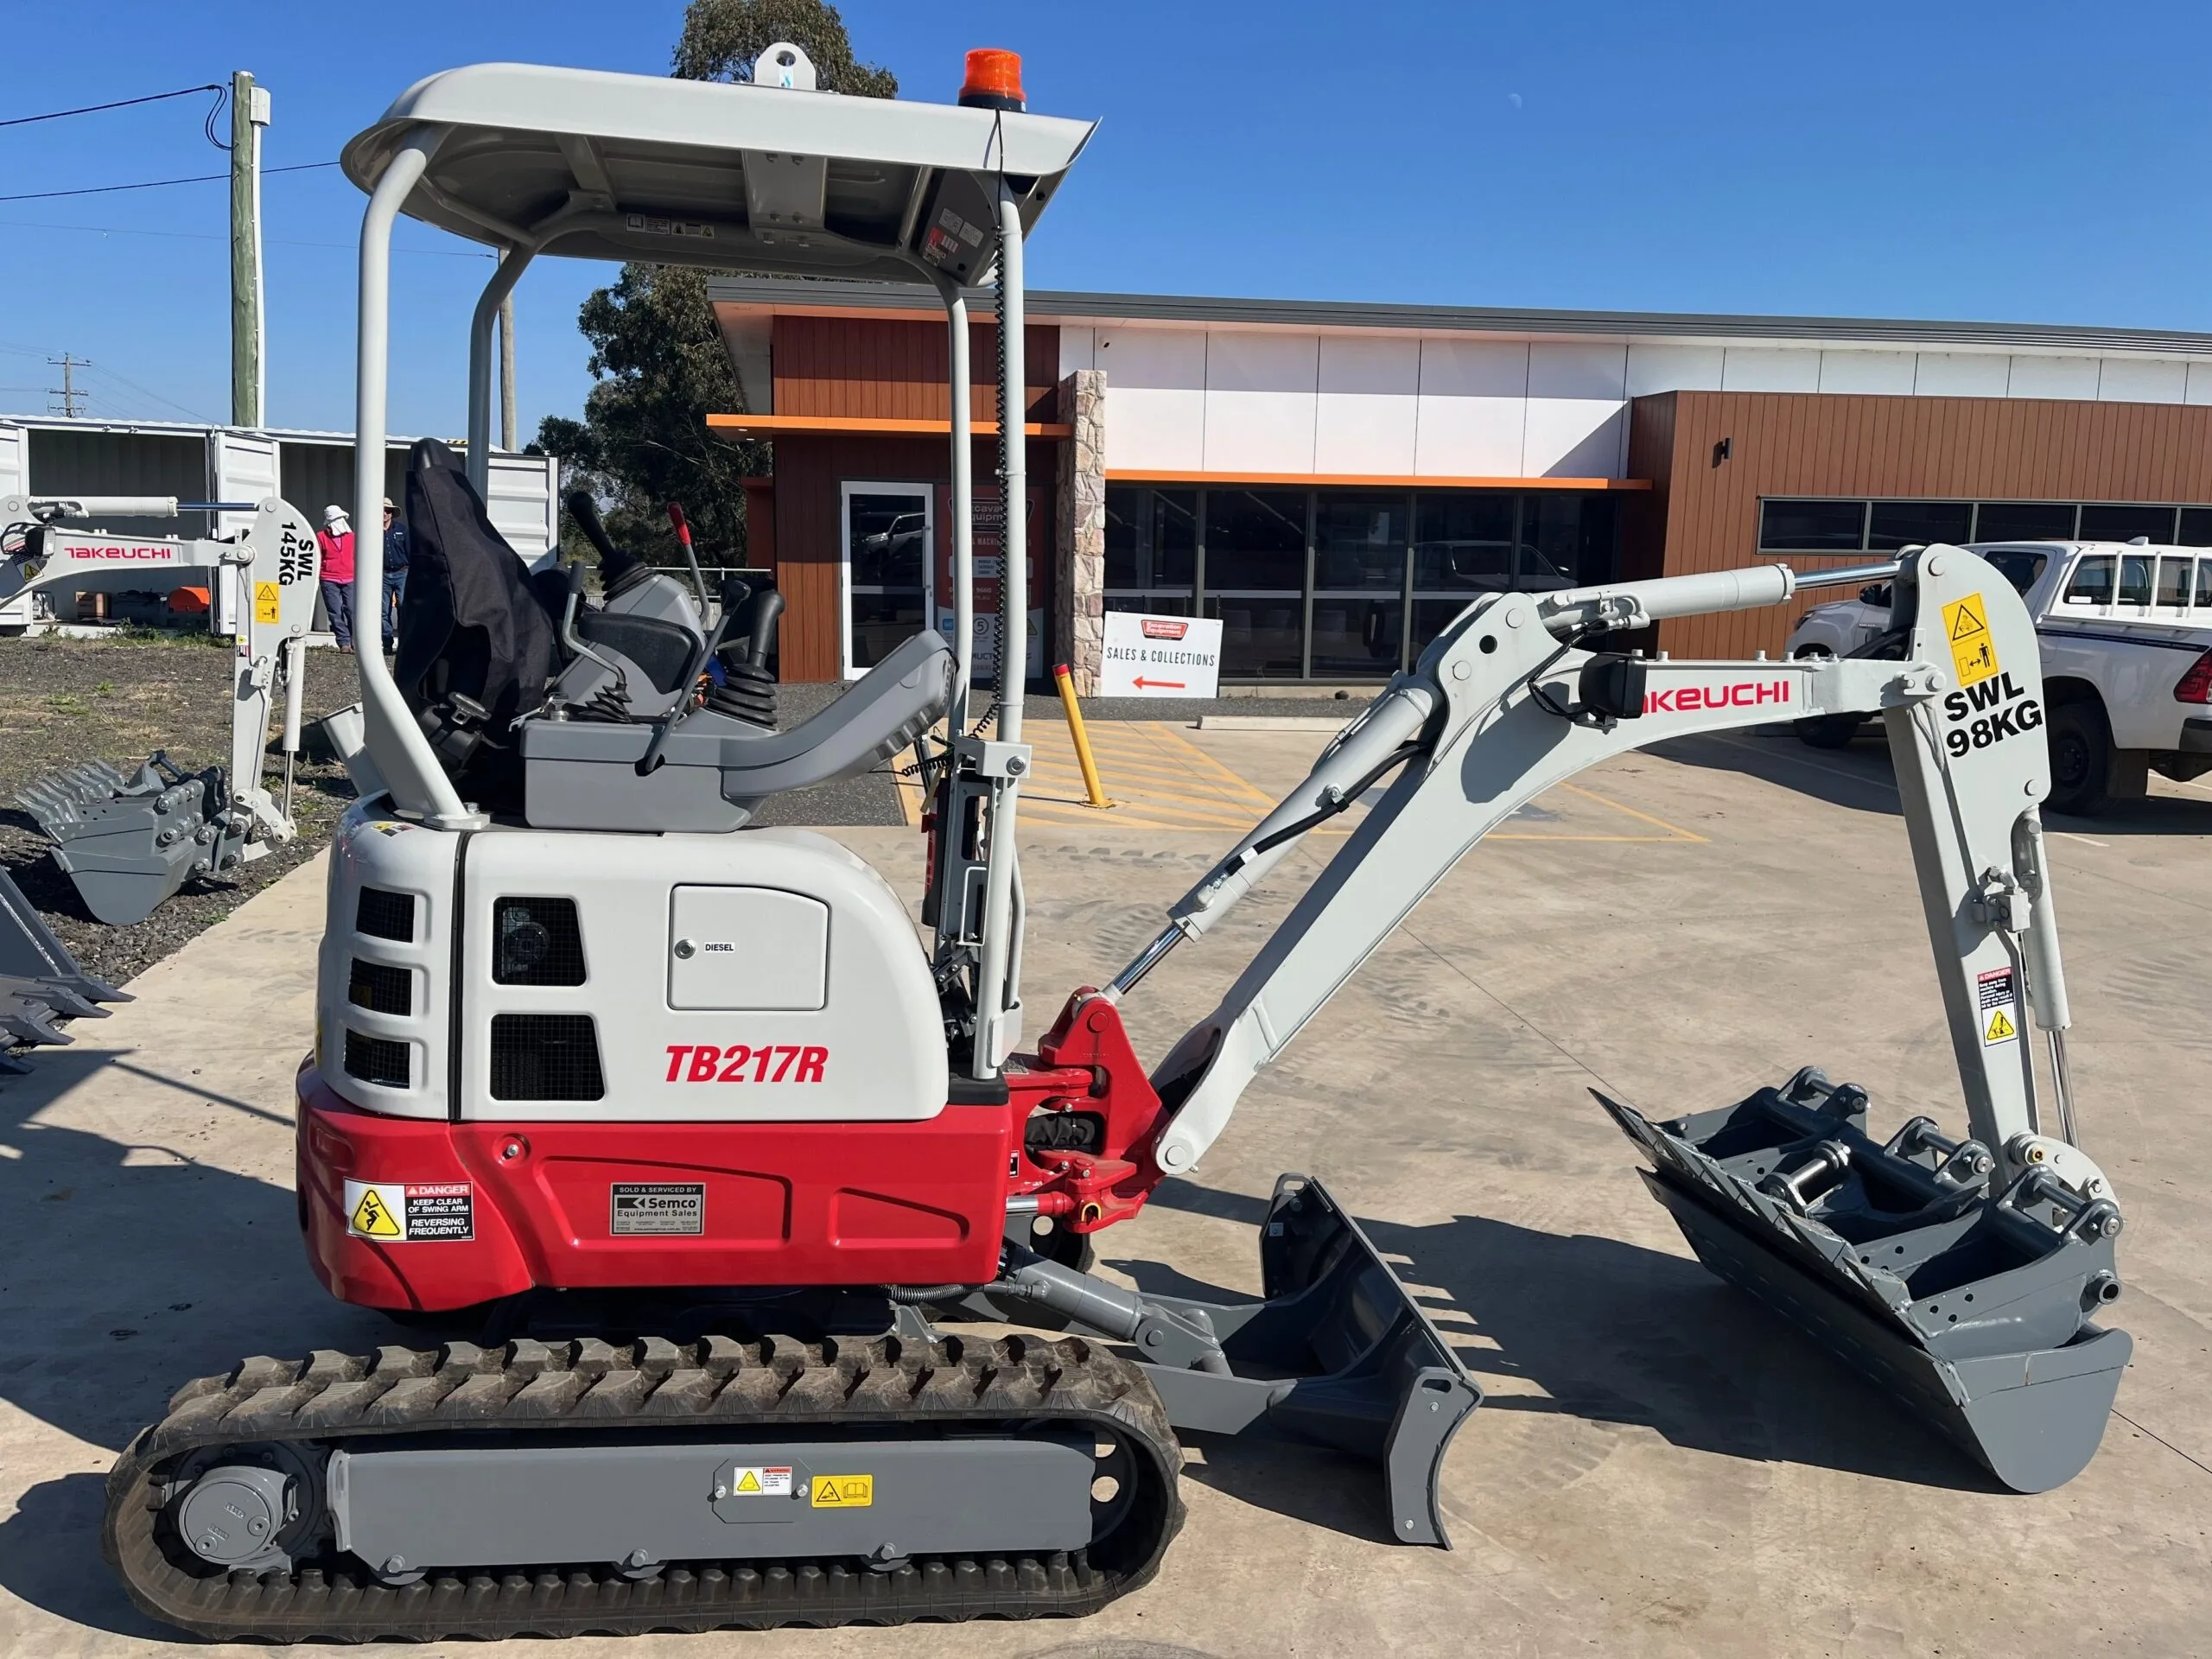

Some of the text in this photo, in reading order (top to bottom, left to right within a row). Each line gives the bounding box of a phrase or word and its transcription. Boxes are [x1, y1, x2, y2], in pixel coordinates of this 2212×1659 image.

[278, 522, 296, 586] 145KG
[297, 539, 314, 581] SWL
[1107, 647, 1215, 666] SALES & COLLECTIONS
[1944, 671, 2024, 721] SWL
[1946, 700, 2043, 758] 98KG
[1985, 969, 2011, 980] DANGER
[665, 1045, 829, 1083] TB217R
[419, 1185, 468, 1195] DANGER
[648, 1198, 696, 1209] Semco
[409, 1226, 469, 1236] FREQUENTLY
[411, 1217, 464, 1227] REVERSING
